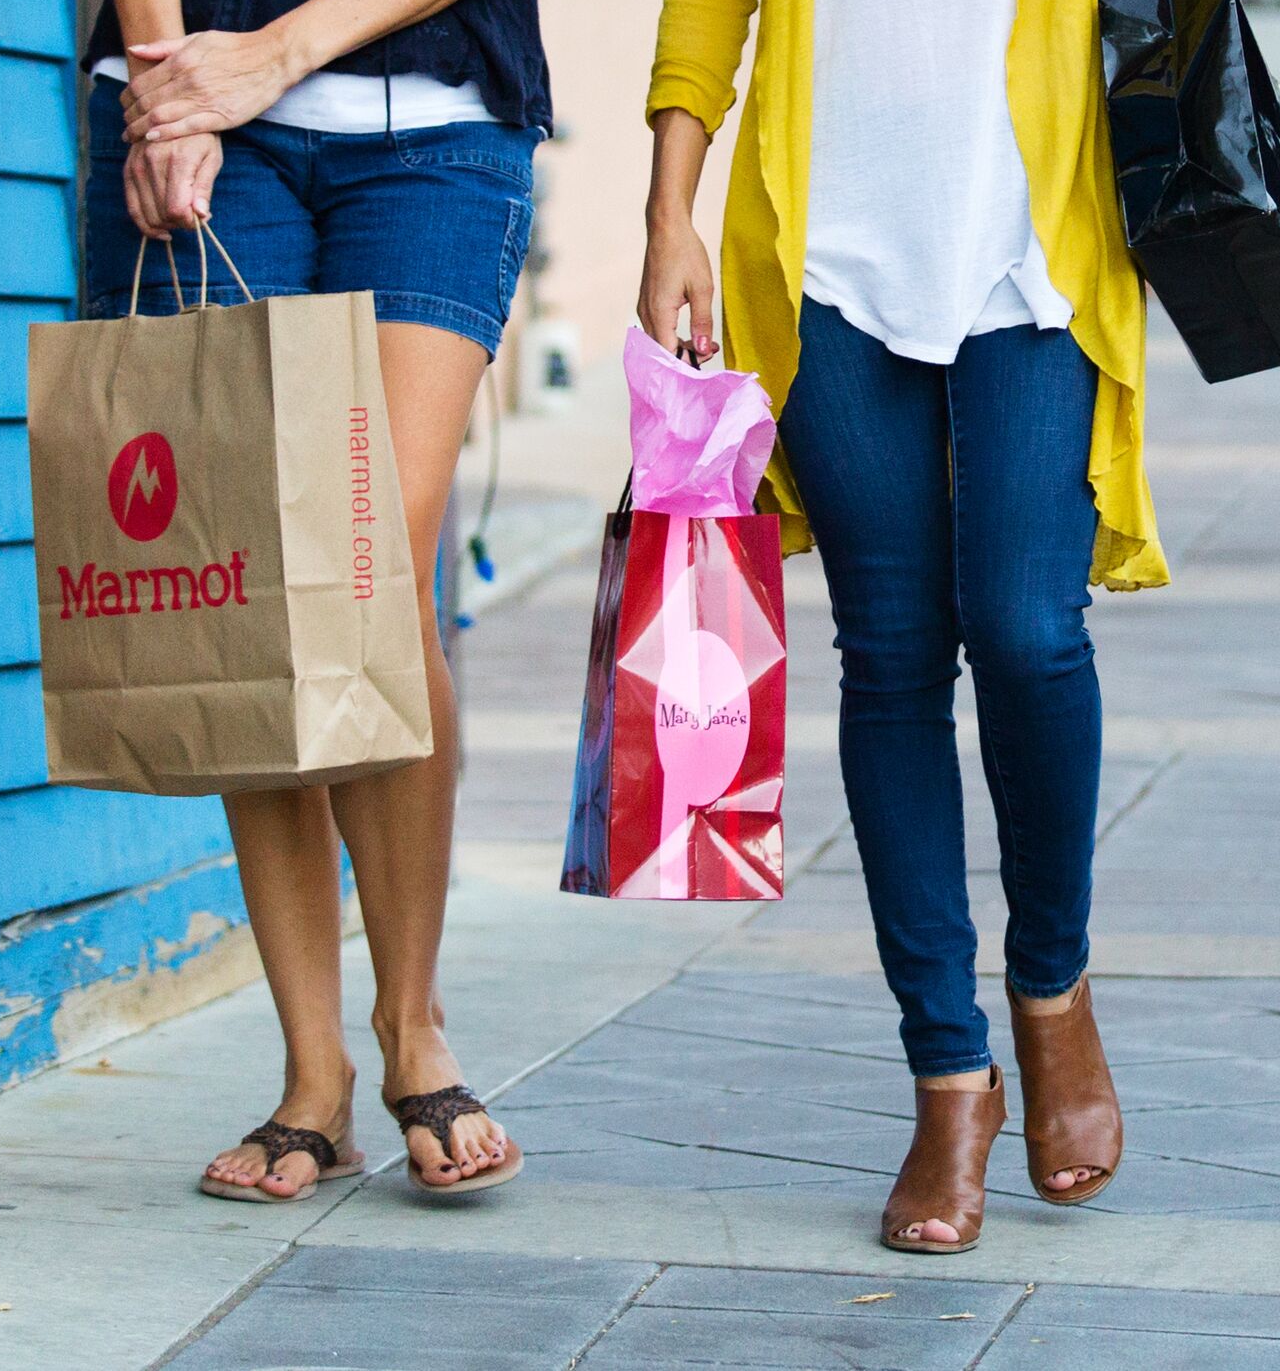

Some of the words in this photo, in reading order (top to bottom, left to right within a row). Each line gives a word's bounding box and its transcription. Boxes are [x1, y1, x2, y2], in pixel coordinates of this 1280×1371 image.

[349, 406, 377, 601] marmot.com
[56, 550, 249, 620] Marmot
[659, 703, 700, 730] Mary
[704, 704, 748, 731] Jane's
